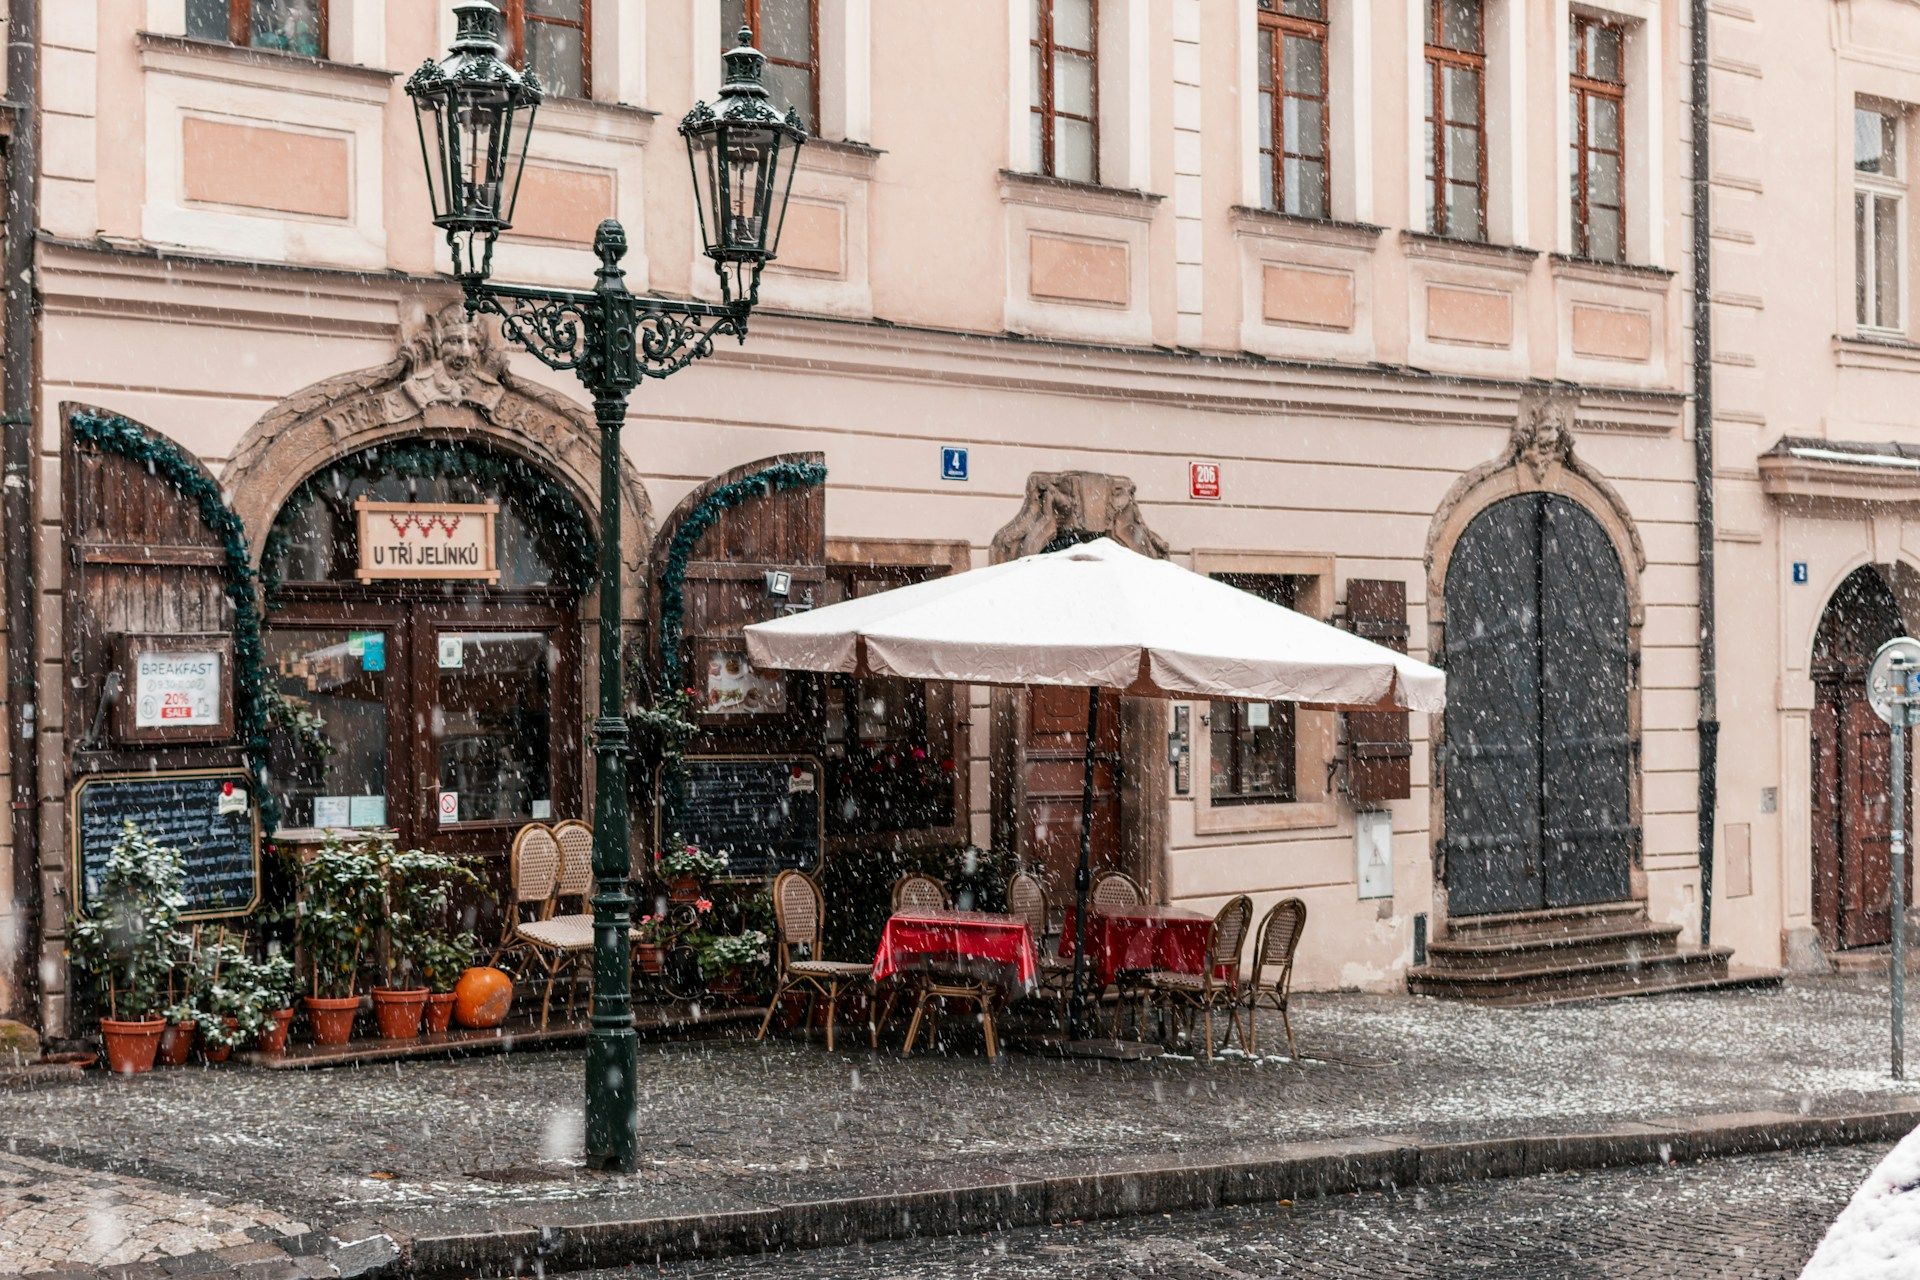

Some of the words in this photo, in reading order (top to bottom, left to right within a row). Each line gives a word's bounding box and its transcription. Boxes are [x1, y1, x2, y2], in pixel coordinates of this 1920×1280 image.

[952, 451, 960, 470] 4
[1197, 465, 1216, 484] 206
[374, 546, 384, 565] U
[388, 541, 412, 565] TŘÍ
[417, 542, 478, 565] JELÍNKŮ
[142, 662, 213, 675] BREAKFAST
[164, 693, 190, 705] 20%
[165, 707, 188, 718] SALE
